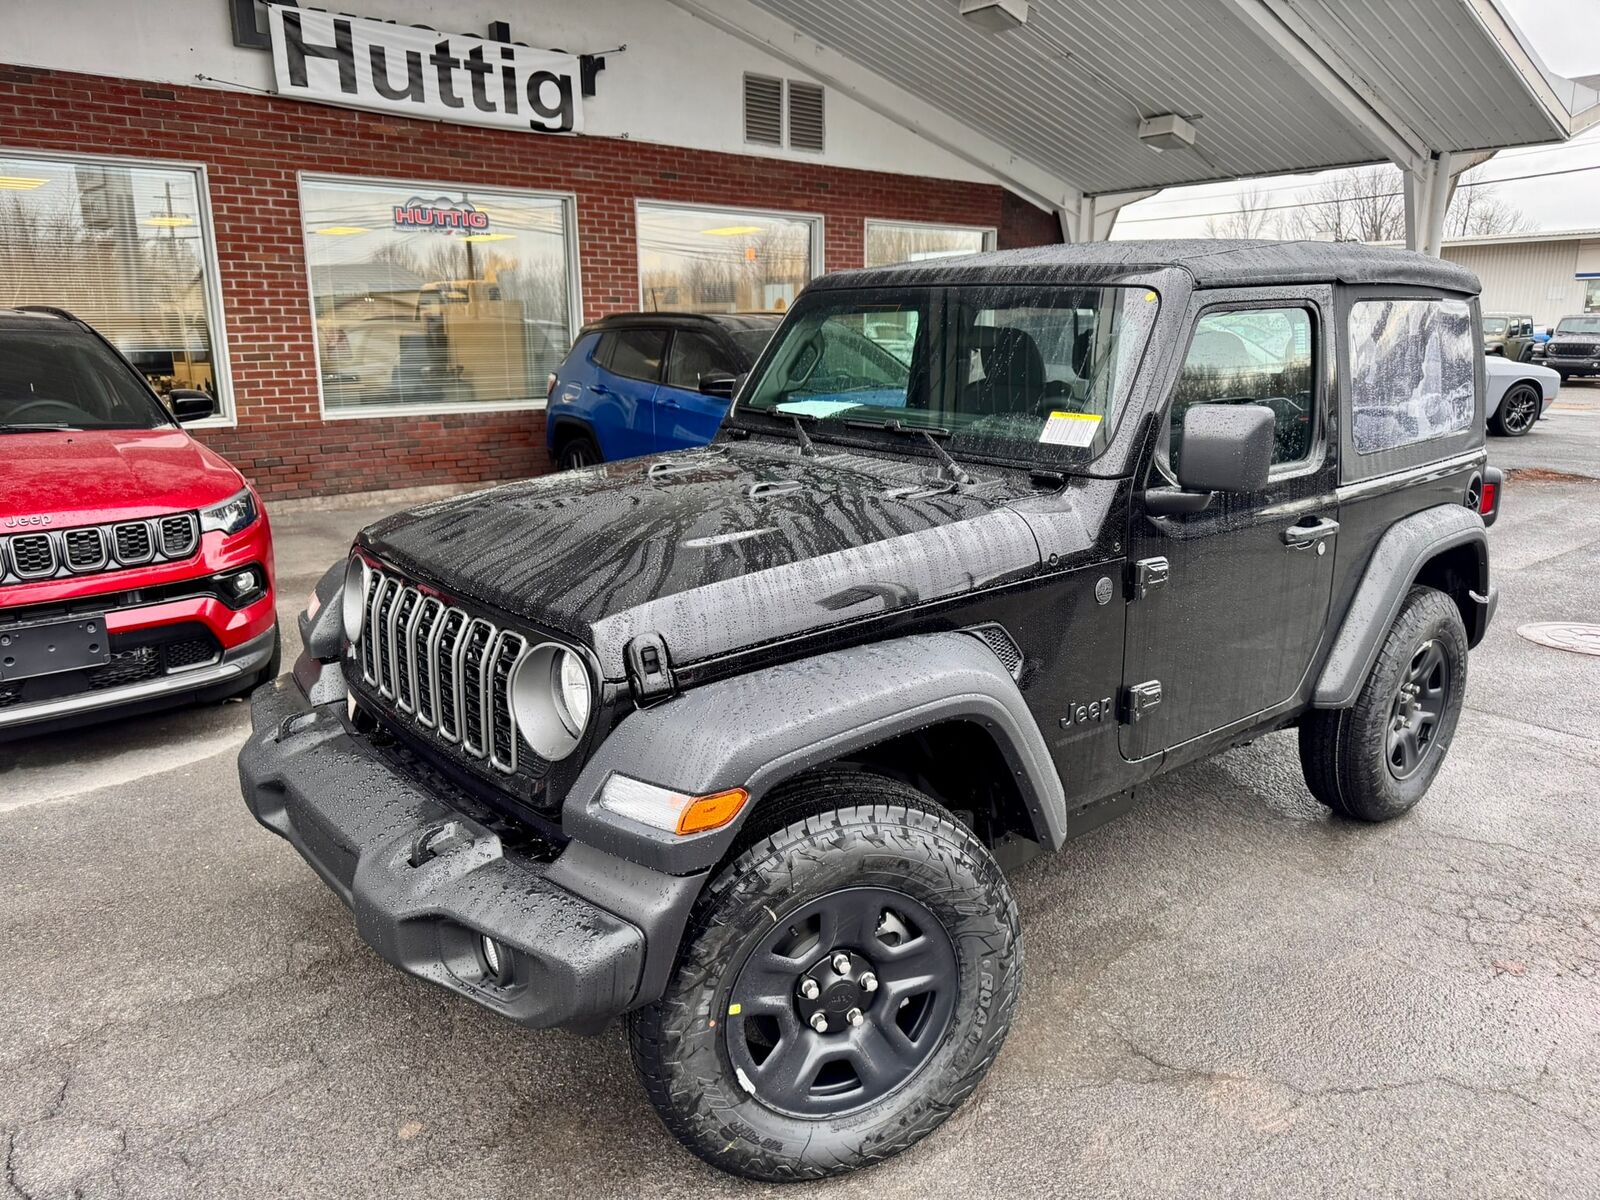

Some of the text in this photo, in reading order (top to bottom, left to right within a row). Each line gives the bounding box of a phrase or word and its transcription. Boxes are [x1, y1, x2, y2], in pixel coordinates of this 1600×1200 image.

[281, 9, 575, 133] Huttig
[394, 206, 489, 229] HUTTIG
[5, 514, 52, 528] Jeep
[1059, 697, 1112, 729] Jeep
